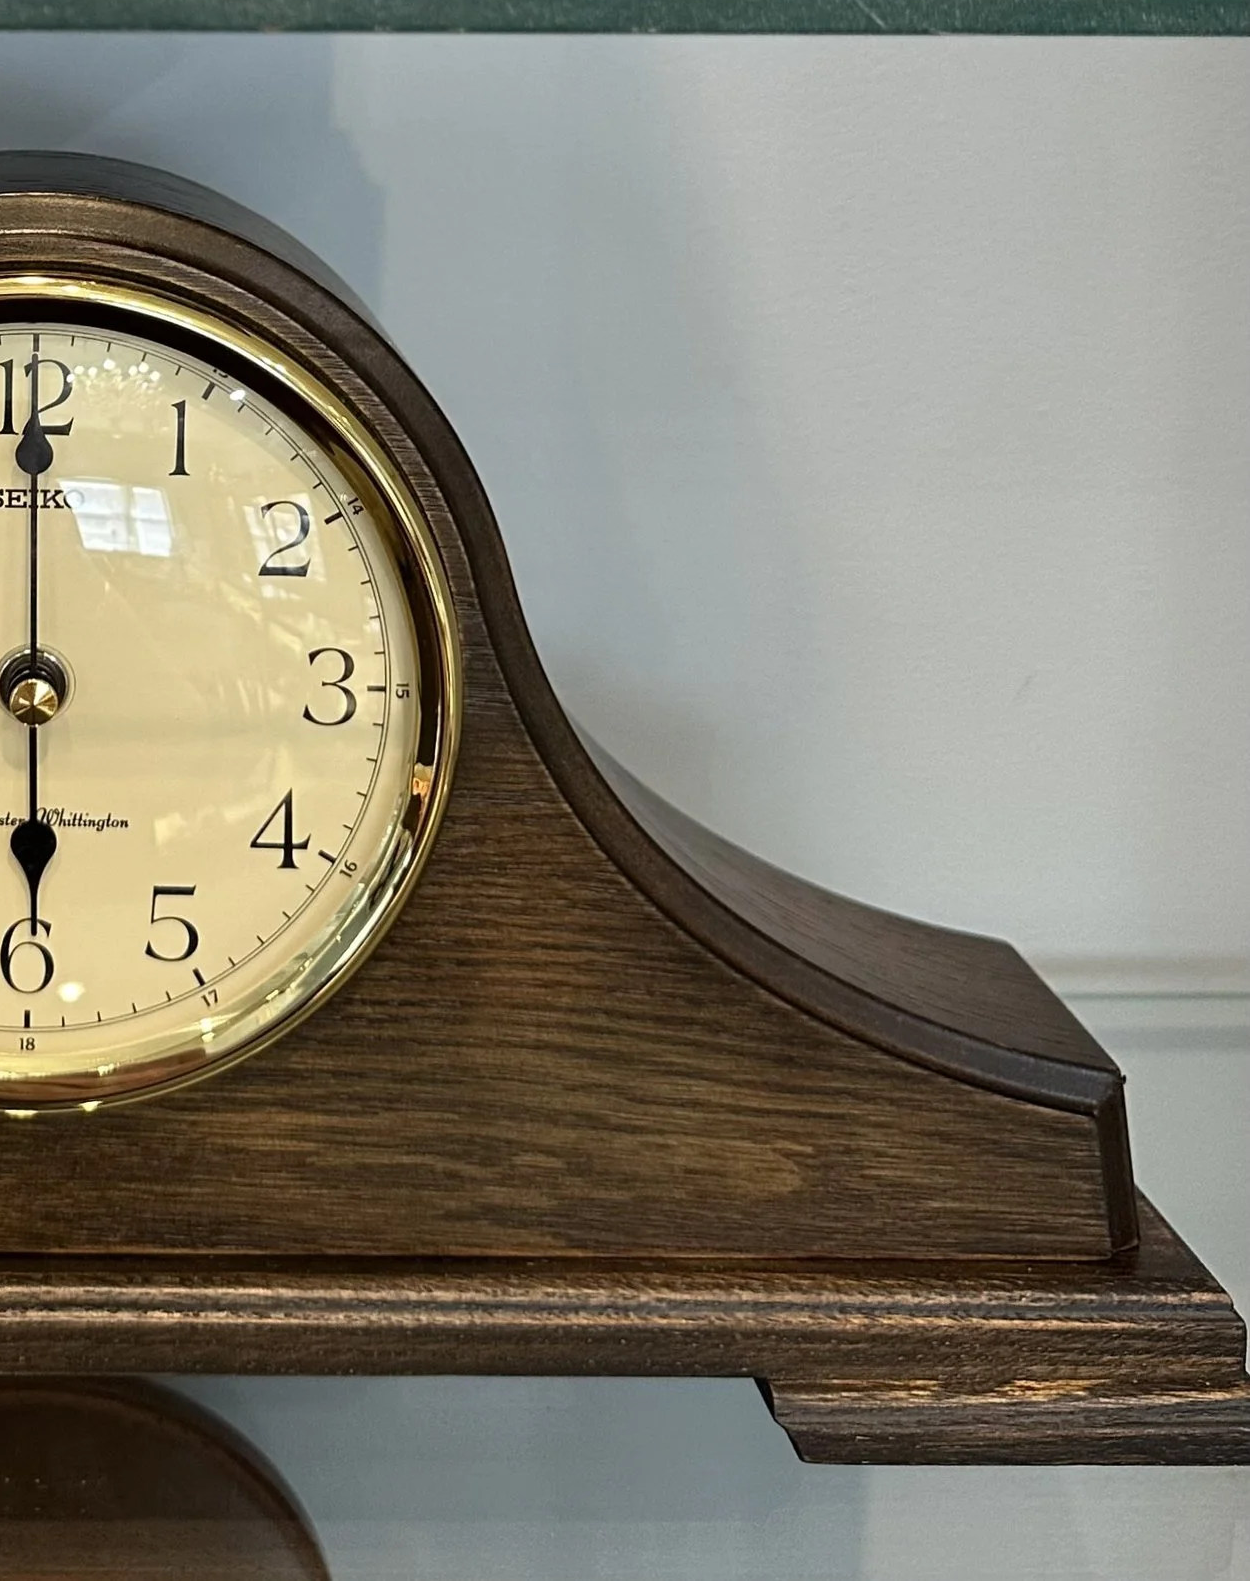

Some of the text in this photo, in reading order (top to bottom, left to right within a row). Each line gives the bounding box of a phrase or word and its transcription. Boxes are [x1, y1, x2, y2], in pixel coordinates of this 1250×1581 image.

[168, 399, 191, 477] 1
[258, 500, 311, 577] 2
[302, 647, 358, 726] 3
[395, 682, 410, 699] 15
[249, 787, 311, 869] 4
[338, 860, 358, 878] 16
[0, 917, 55, 994] 6
[144, 884, 199, 962] 5
[200, 989, 220, 1007] 17
[18, 1036, 36, 1052] 18
